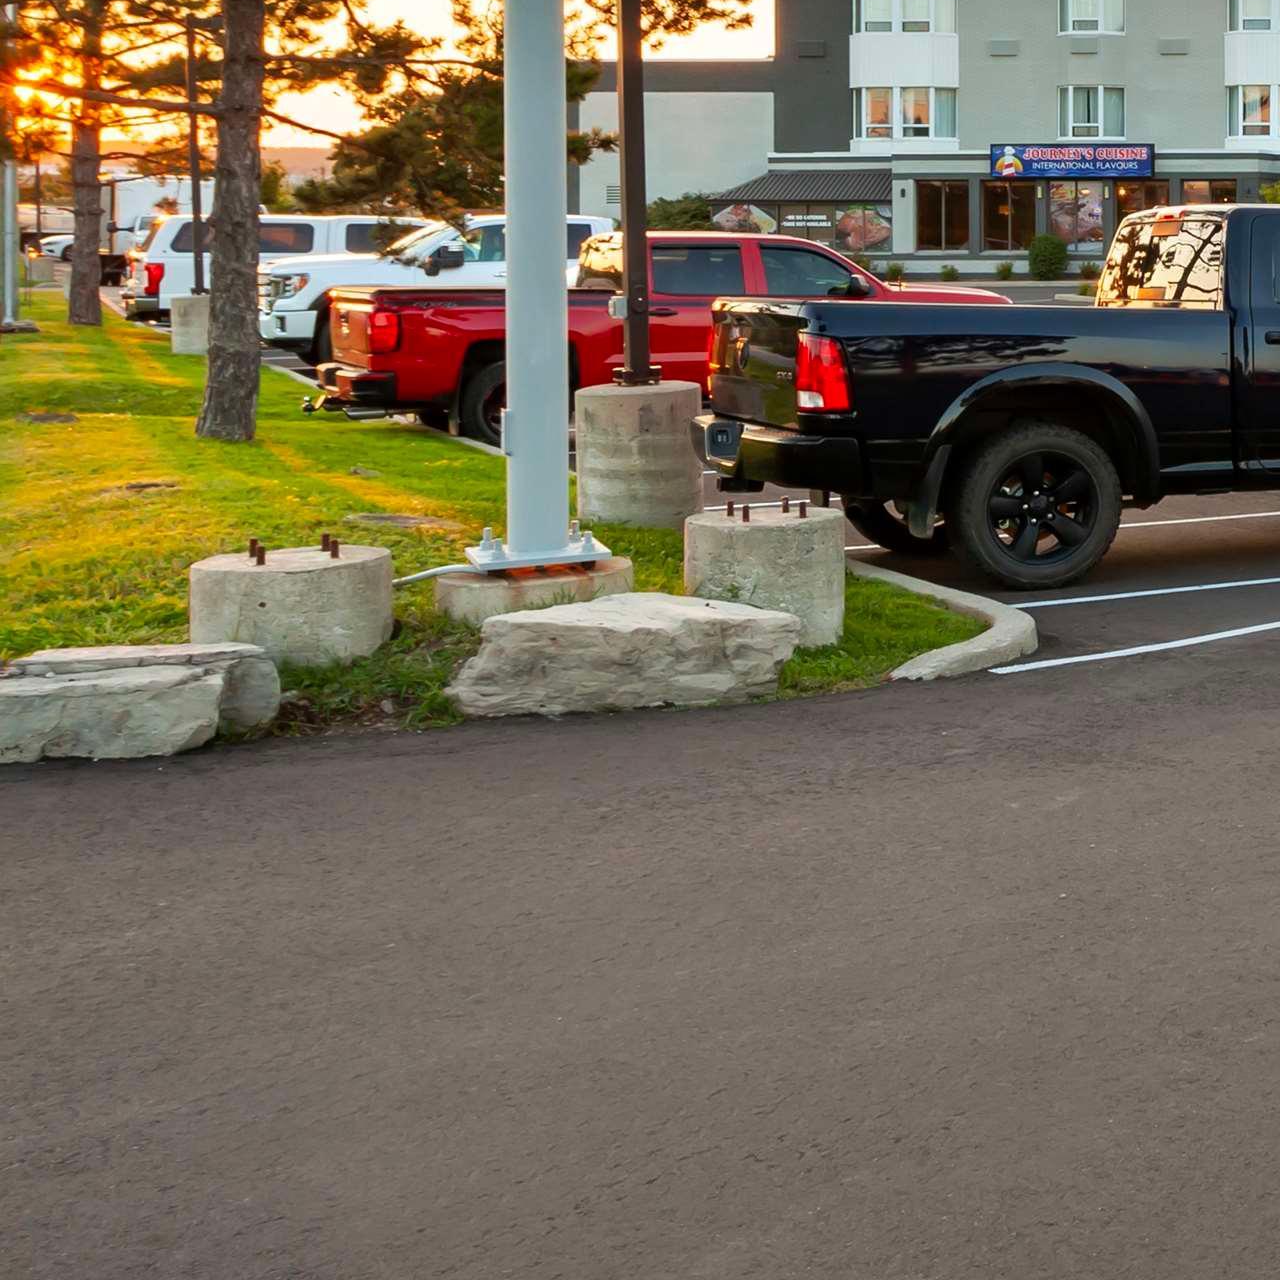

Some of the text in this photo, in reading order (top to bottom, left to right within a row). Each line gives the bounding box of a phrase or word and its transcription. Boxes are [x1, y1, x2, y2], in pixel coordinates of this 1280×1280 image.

[1023, 147, 1148, 160] JOURNEY'S CUISINE
[1032, 161, 1138, 170] INTERNATIONAL FLAVOURS
